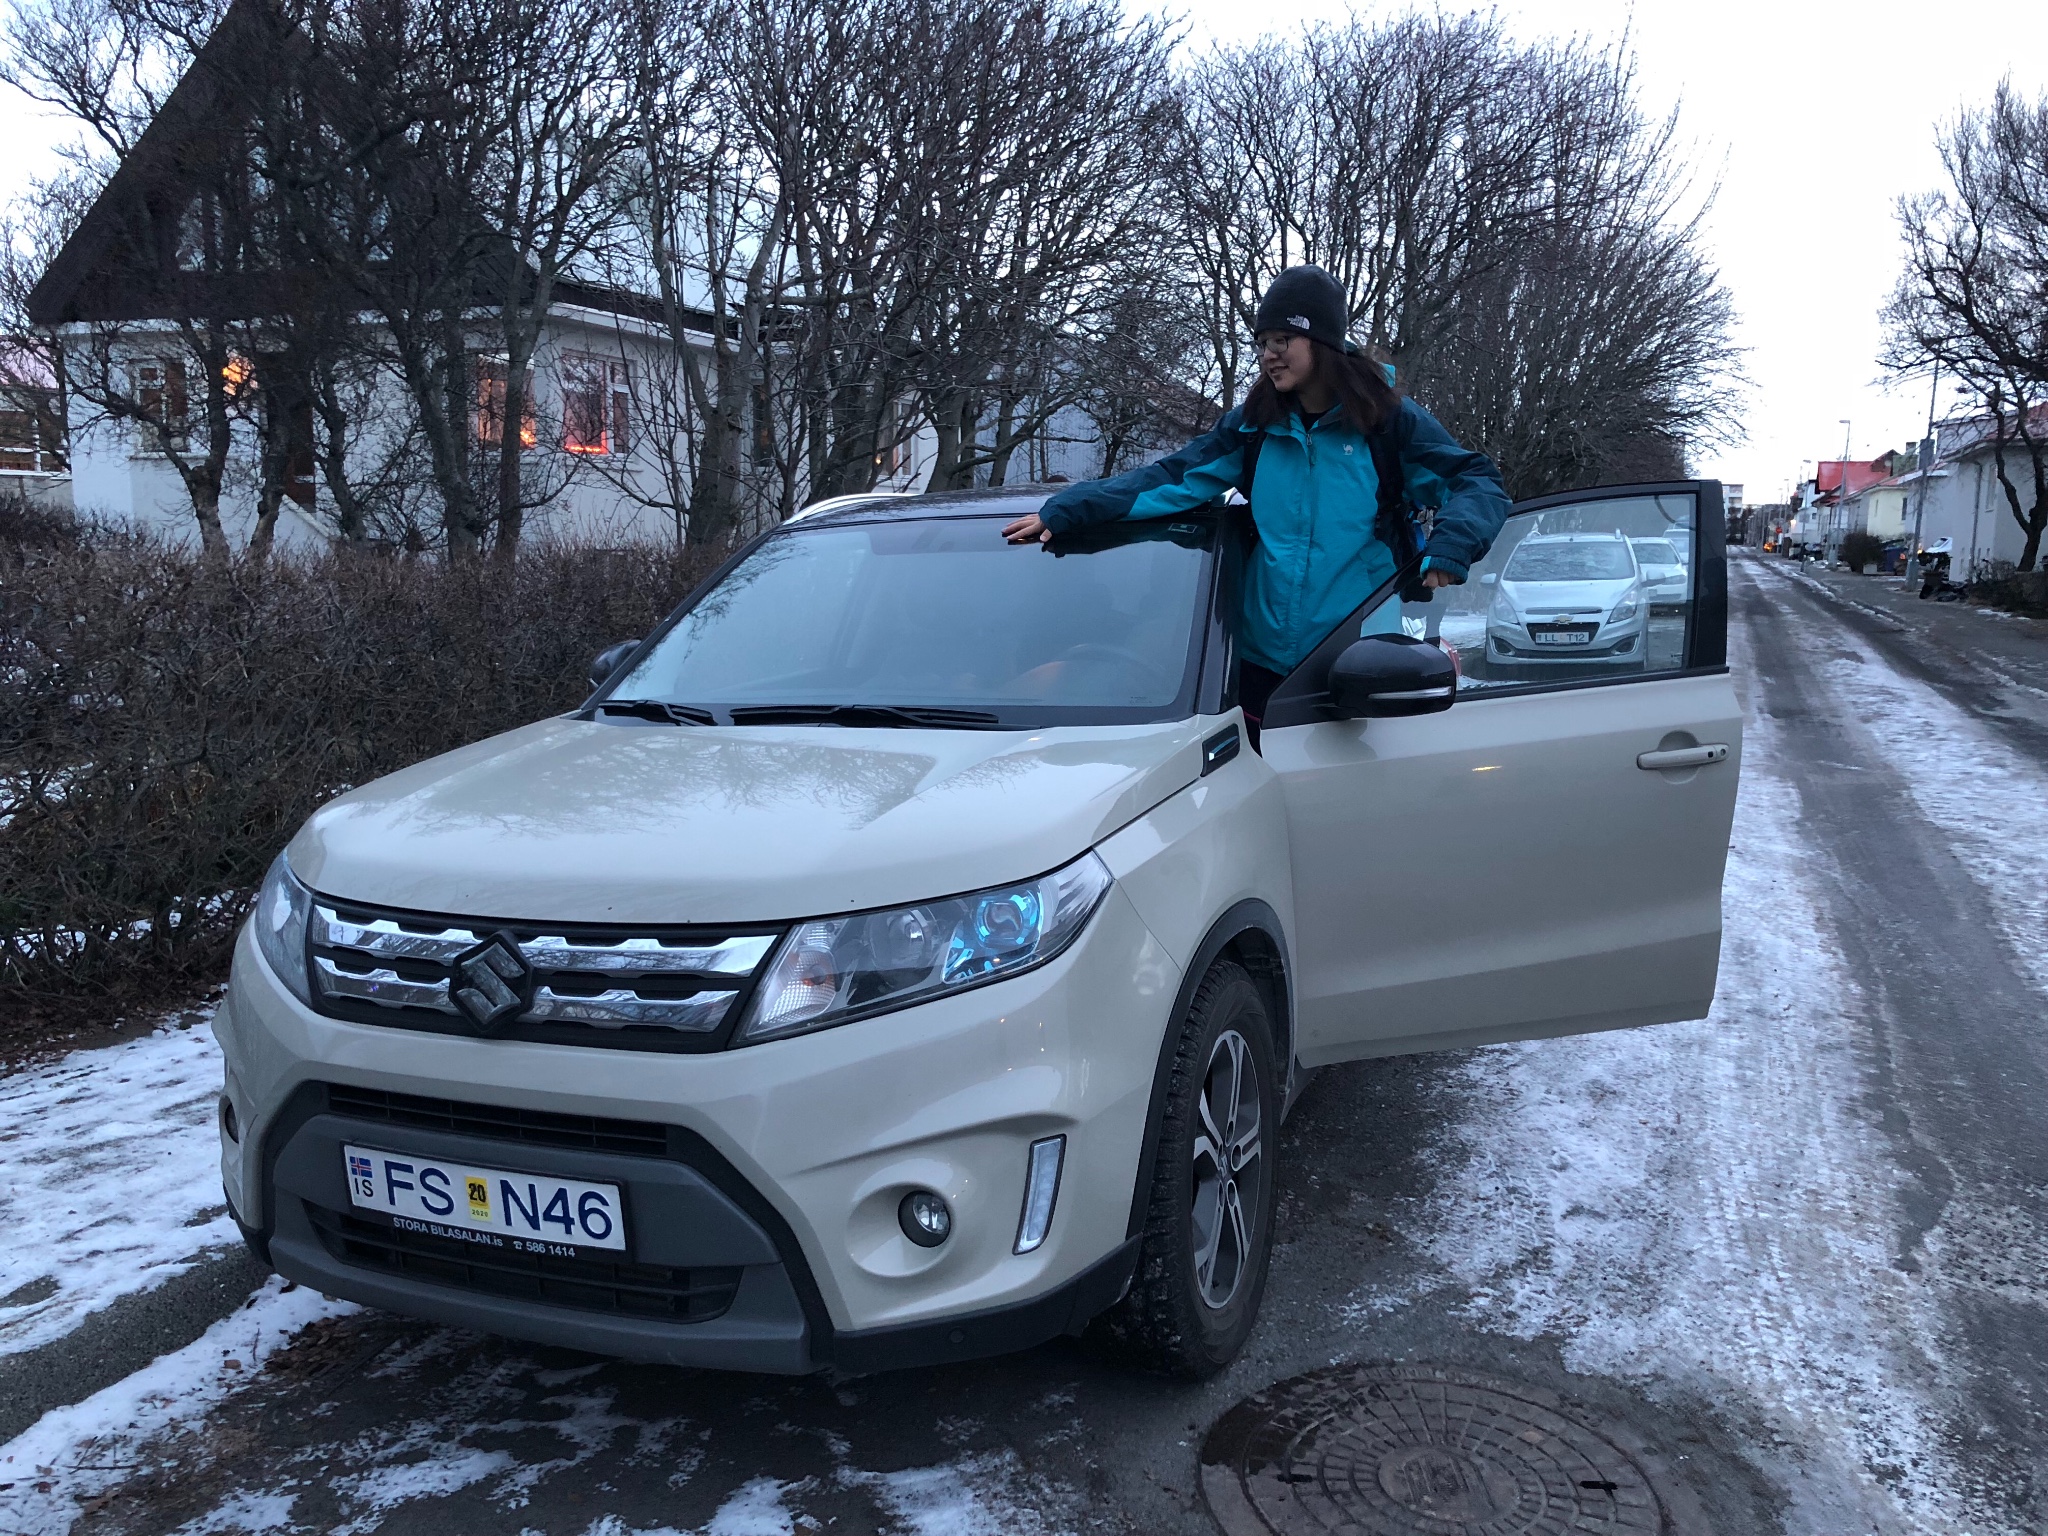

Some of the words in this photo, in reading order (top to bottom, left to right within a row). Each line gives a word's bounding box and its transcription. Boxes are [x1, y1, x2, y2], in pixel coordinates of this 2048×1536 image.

[1545, 634, 1558, 642] LL
[1567, 633, 1585, 642] T12
[354, 1178, 374, 1198] IS
[468, 1183, 487, 1203] 20
[384, 1160, 455, 1216] FS
[500, 1179, 613, 1240] N46
[471, 1209, 489, 1217] 2020
[393, 1217, 429, 1234] STORA
[526, 1241, 546, 1253] 586
[549, 1244, 575, 1258] 1414
